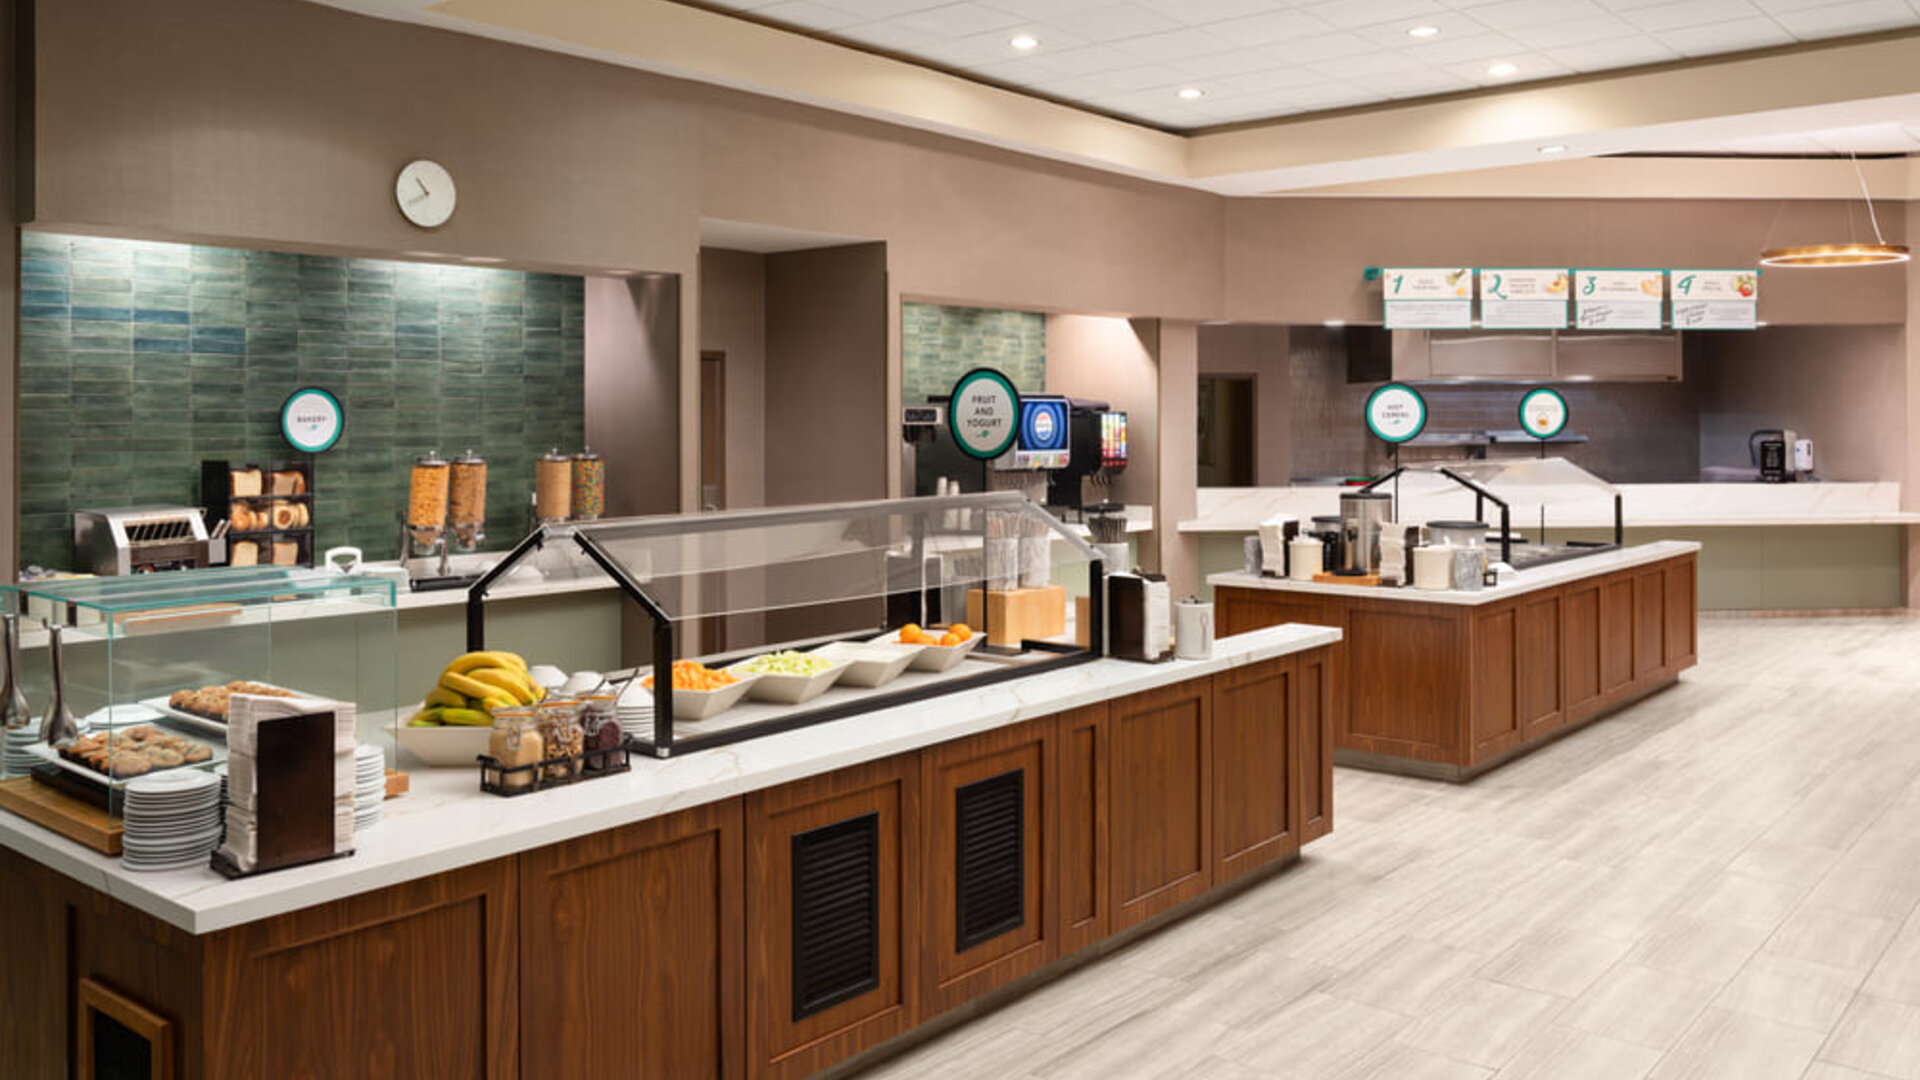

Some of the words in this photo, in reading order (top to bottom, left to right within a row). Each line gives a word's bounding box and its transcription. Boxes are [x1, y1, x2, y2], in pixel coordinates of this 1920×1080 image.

[1393, 274, 1403, 294] 1
[1487, 273, 1507, 300] 2
[1582, 275, 1597, 296] 3
[1677, 274, 1697, 295] 4
[972, 395, 996, 404] FRUIT
[975, 406, 994, 416] AND
[967, 418, 1001, 428] YOGURT
